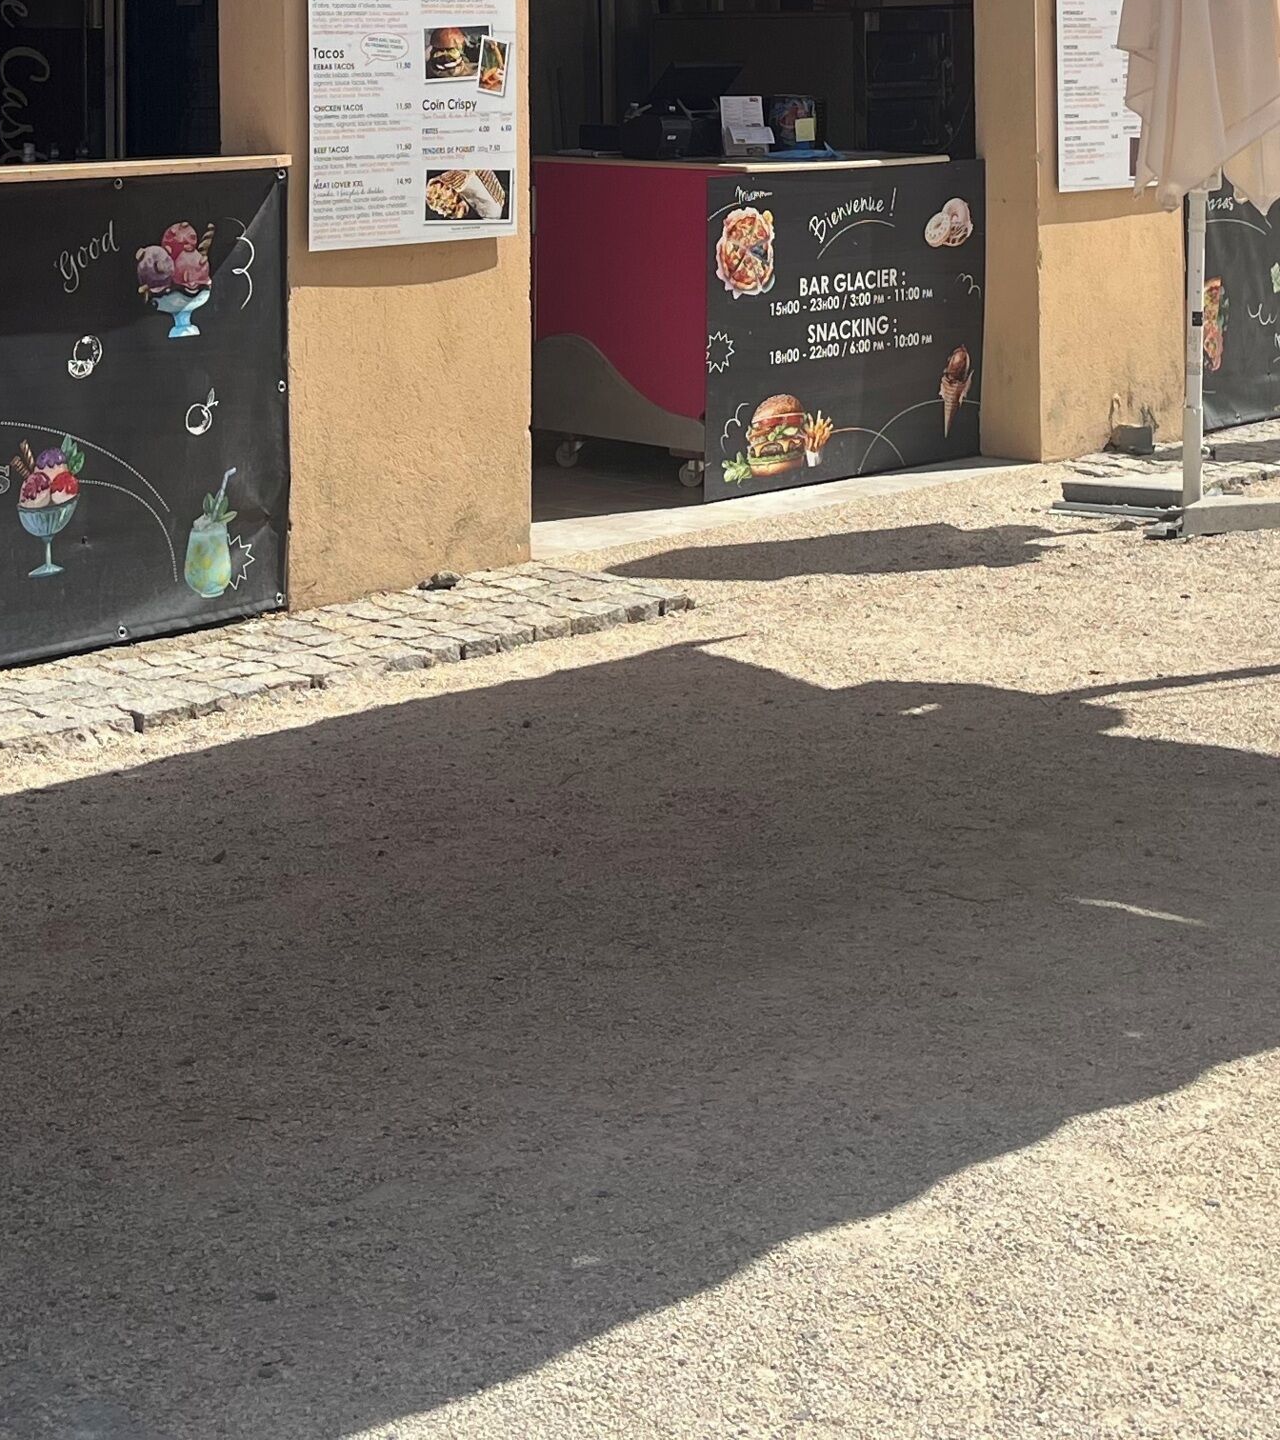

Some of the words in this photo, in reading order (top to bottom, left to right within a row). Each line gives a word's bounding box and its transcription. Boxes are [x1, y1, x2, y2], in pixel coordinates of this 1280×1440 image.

[313, 47, 345, 59] Tacos
[0, 45, 51, 161] Cas
[422, 99, 445, 112] Coin
[448, 98, 477, 114] Crispy
[808, 196, 885, 244] Bienvenue
[799, 275, 830, 297] BAR
[833, 268, 898, 294] GLACIER
[849, 292, 871, 308] 3:00
[873, 294, 885, 304] PM
[894, 286, 920, 302] 11:00
[921, 288, 933, 299] PM
[807, 315, 889, 344] SNACKING
[849, 339, 871, 355] 6:00
[873, 341, 885, 351] PM
[893, 332, 920, 348] 10:00
[921, 334, 933, 345] PM
